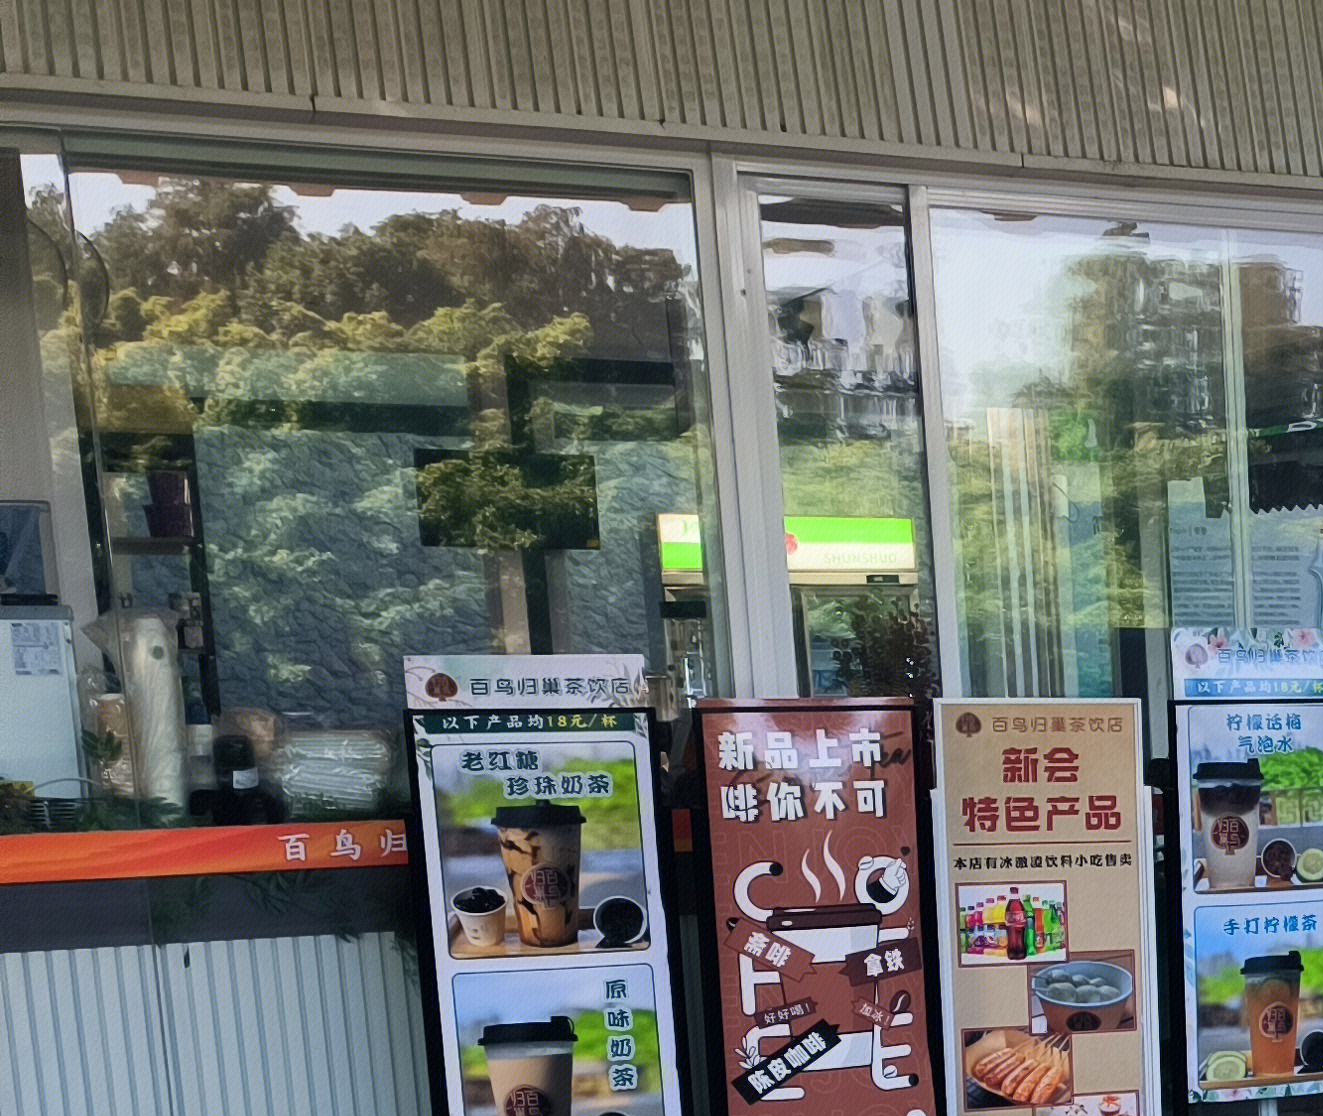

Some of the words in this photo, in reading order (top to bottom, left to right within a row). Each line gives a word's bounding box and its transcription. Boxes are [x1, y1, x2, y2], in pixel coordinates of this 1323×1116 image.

[823, 553, 898, 564] SHUNSHUO
[469, 677, 631, 697] 百鸟归巢茶饮店
[441, 713, 618, 730] 以下产品均18元/杯
[991, 716, 1124, 734] 百鸟归巢茶饮店
[1226, 713, 1302, 732] 柠檬话梅
[717, 727, 882, 771] 新品上市
[1237, 735, 1294, 754] 气泡水
[459, 749, 540, 772] 老红糖
[1001, 746, 1080, 784] 新会
[505, 773, 612, 797] 珍珠奶茶
[719, 779, 885, 823] 啡你不可
[961, 794, 1122, 833] 特色产品
[277, 828, 408, 862] 百鸟归
[1222, 914, 1318, 936] 手打柠檬茶
[863, 948, 905, 977] 拿铁
[605, 978, 637, 1089] 原味奶茶
[747, 1030, 828, 1095] 陈皮咖啡
